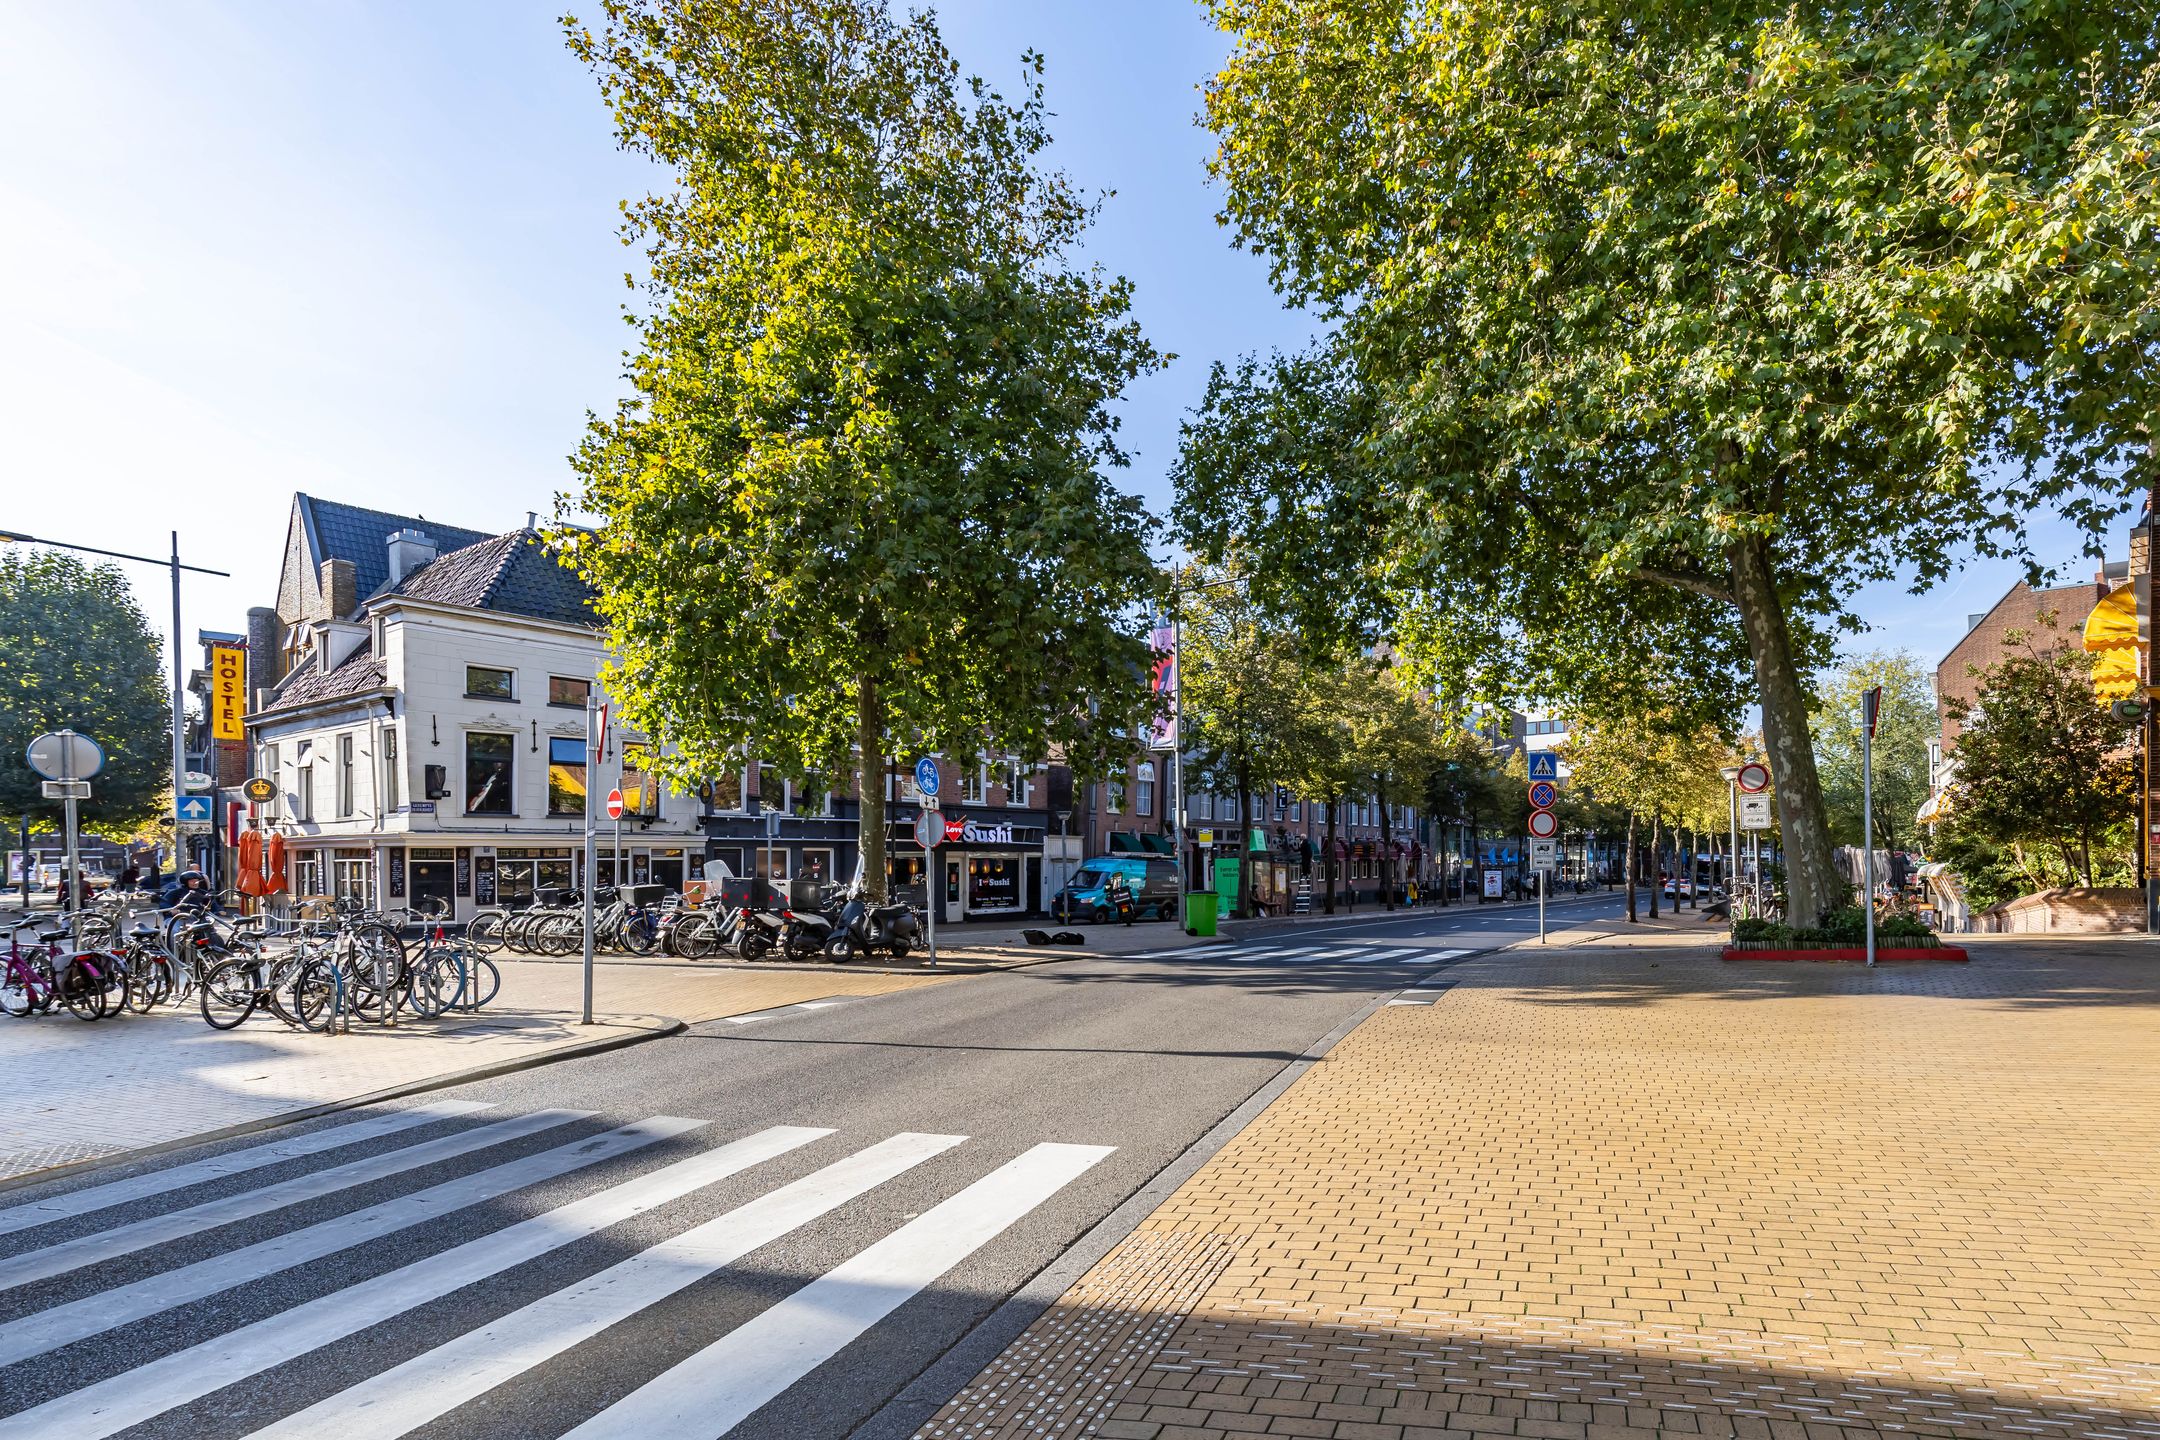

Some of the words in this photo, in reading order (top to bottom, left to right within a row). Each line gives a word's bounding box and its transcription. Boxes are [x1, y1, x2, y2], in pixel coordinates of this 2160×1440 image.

[220, 654, 236, 733] HOSTEL
[945, 825, 963, 833] Love
[963, 824, 1013, 843] Sushi
[978, 878, 983, 887] I
[989, 878, 1010, 887] Sushi
